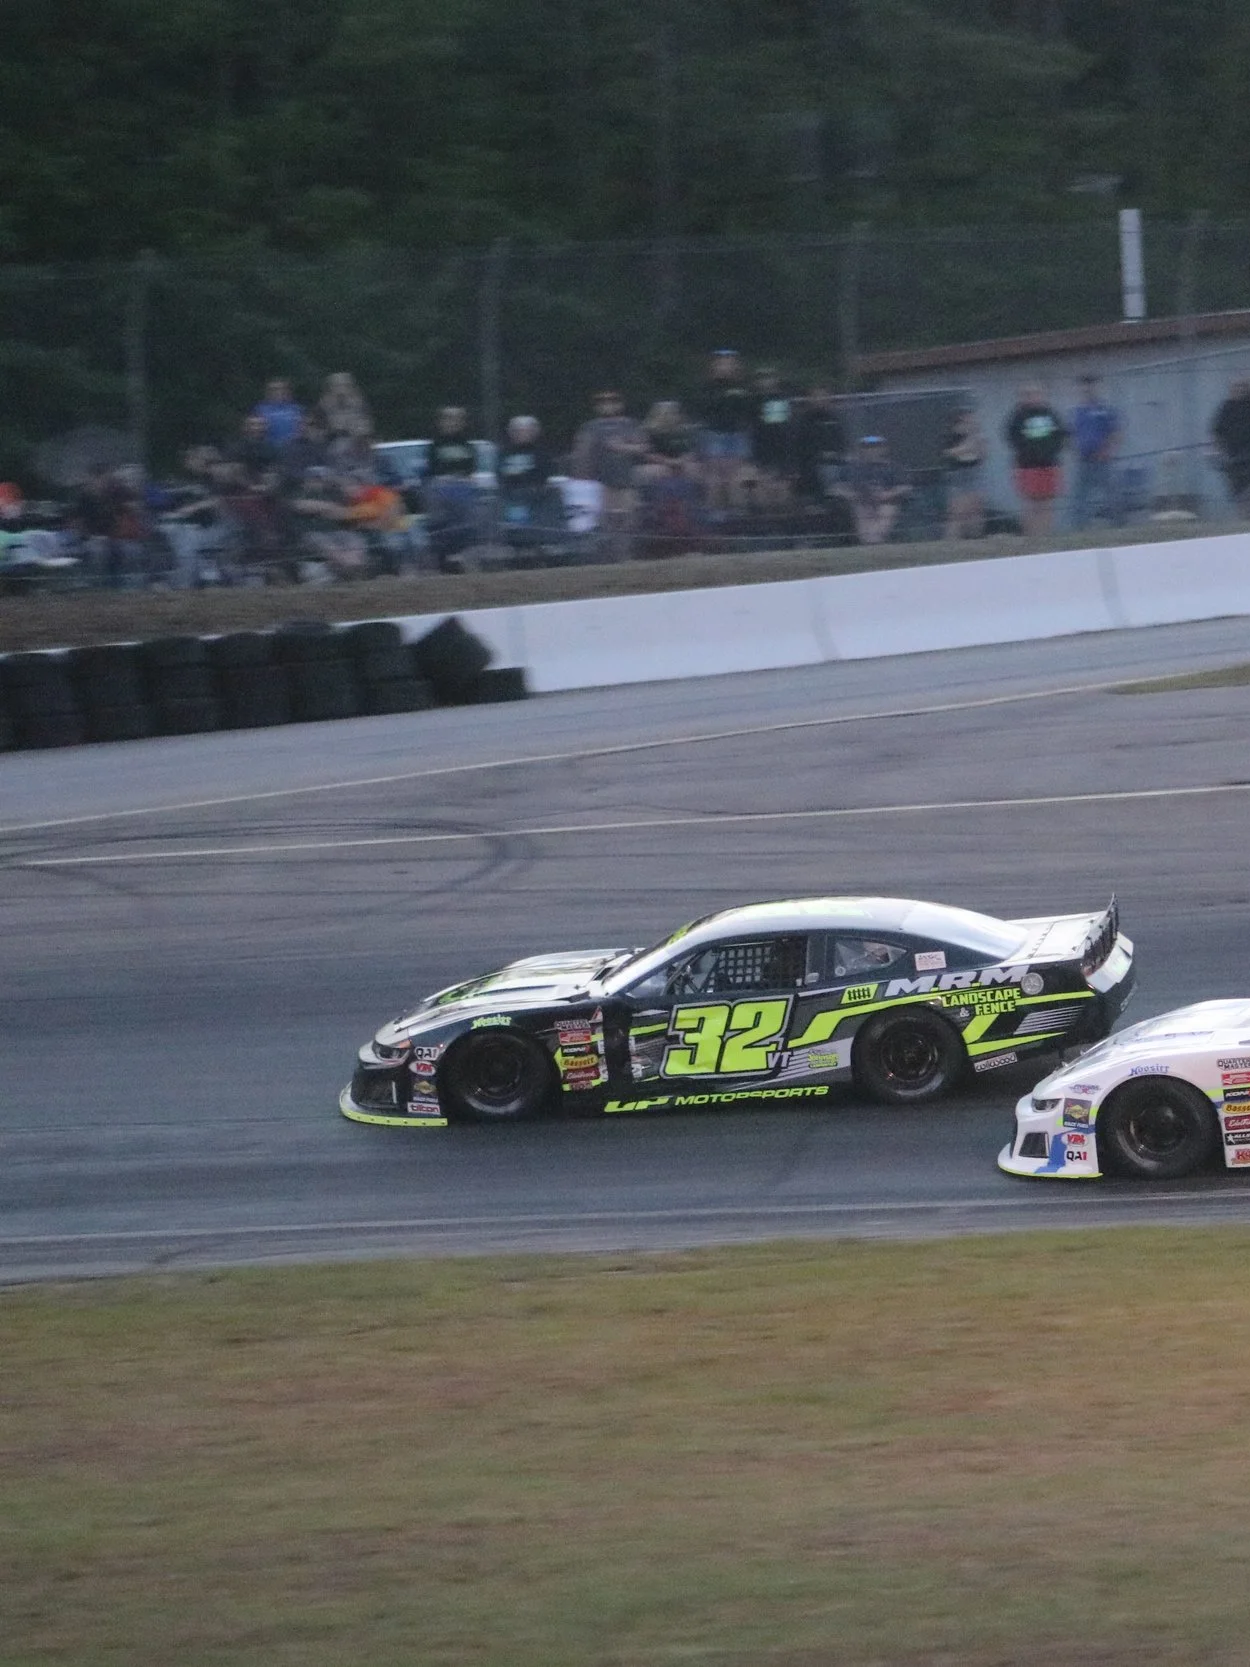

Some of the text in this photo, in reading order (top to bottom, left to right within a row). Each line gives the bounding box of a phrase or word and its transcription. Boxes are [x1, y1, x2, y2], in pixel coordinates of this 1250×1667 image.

[942, 987, 1021, 1008] LANDSCAPE
[959, 1001, 1016, 1018] & FENCE
[664, 1000, 788, 1075] 32
[767, 1051, 791, 1069] VT
[674, 1085, 830, 1106] MOTORSPORTS
[1066, 1151, 1088, 1161] QA1
